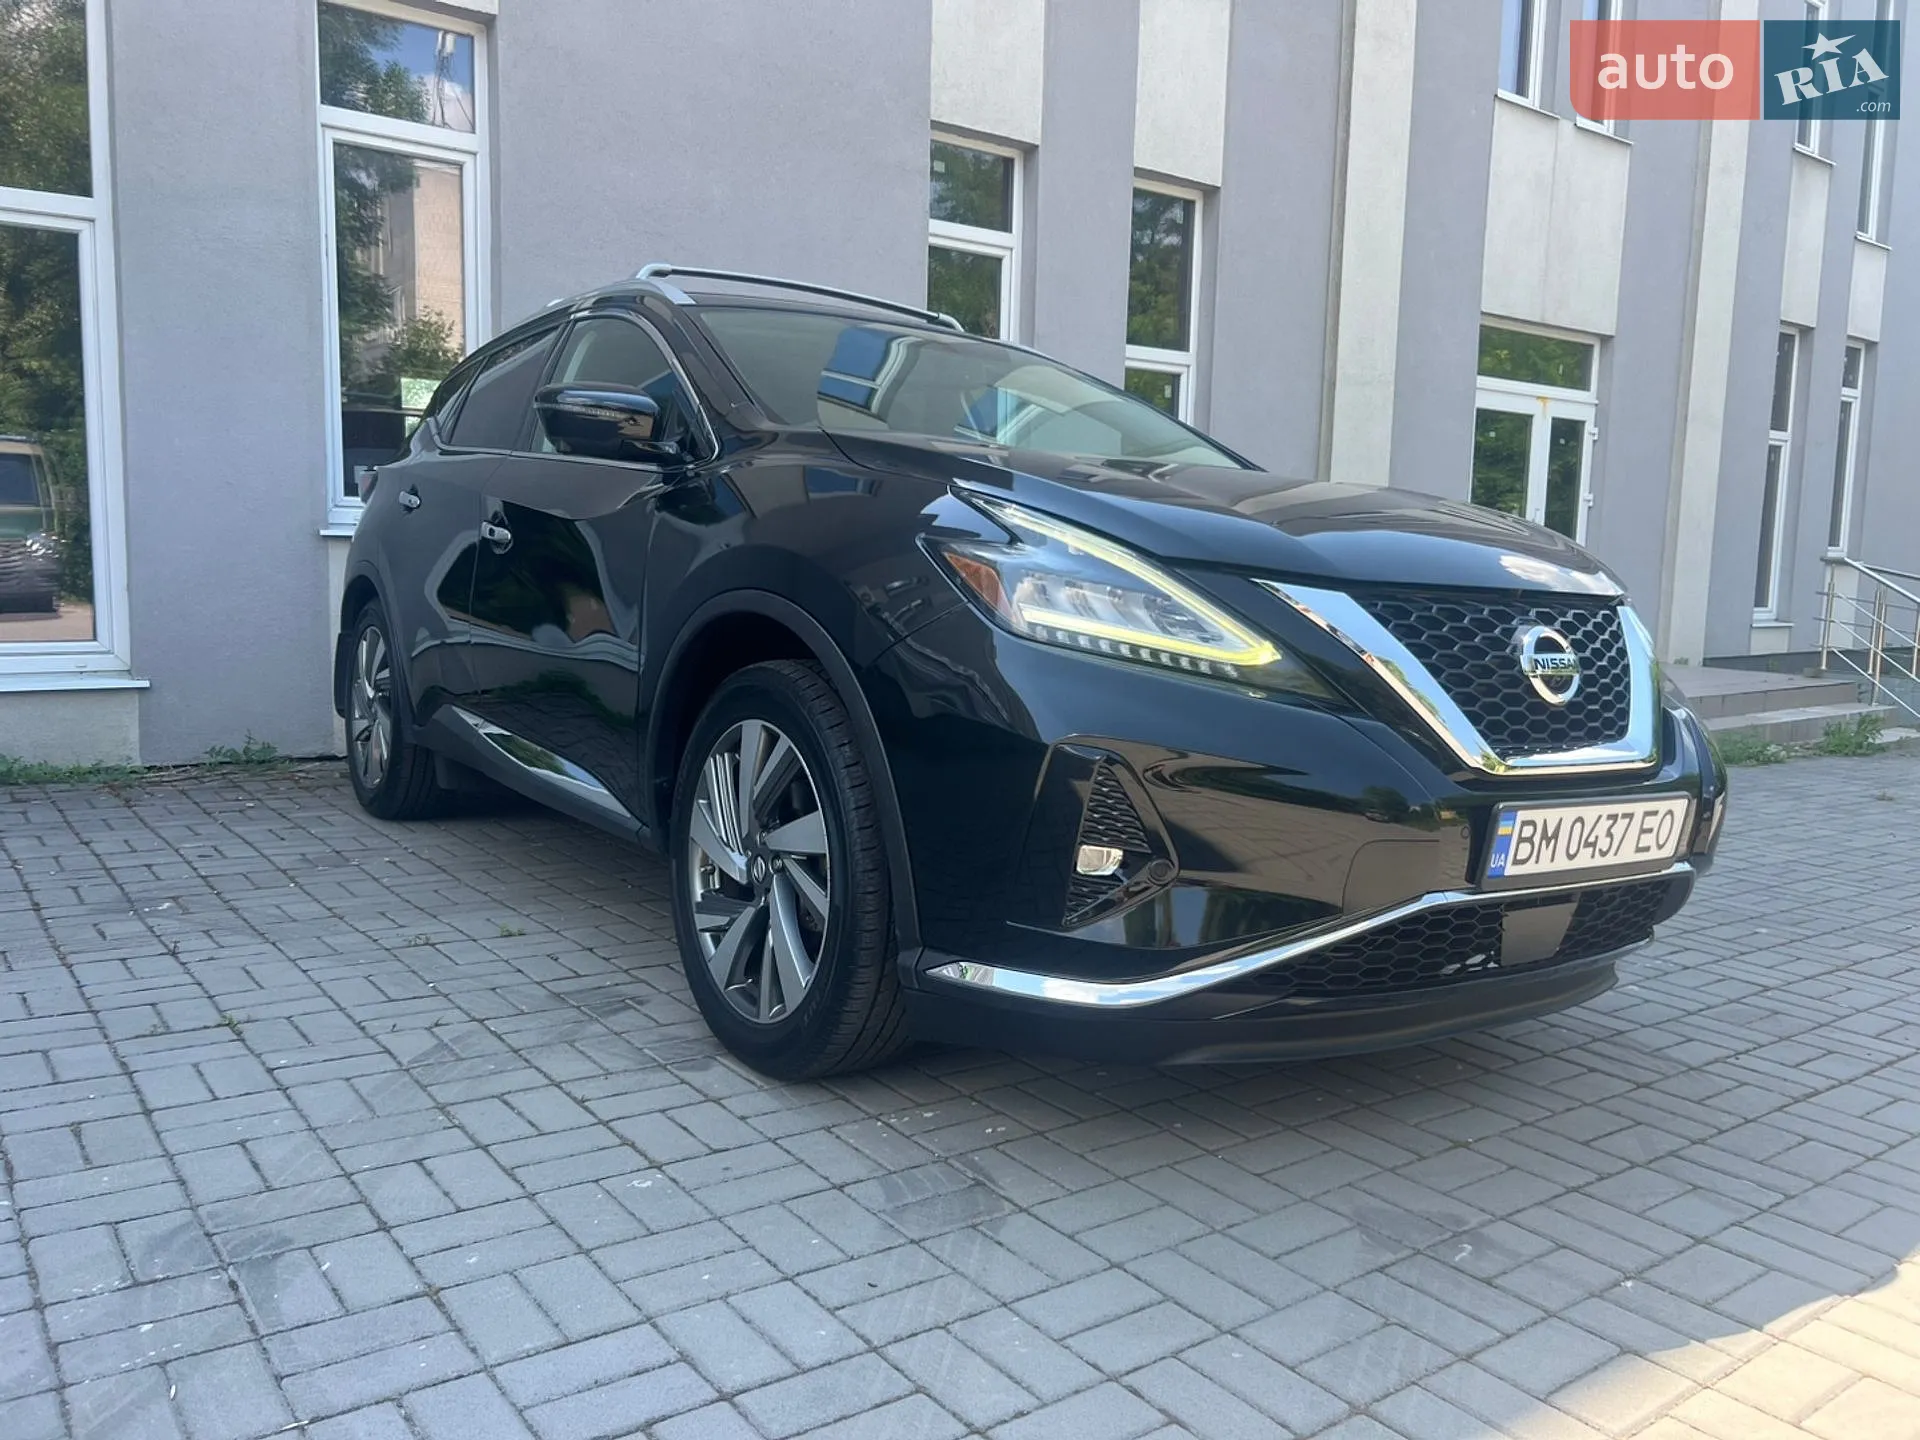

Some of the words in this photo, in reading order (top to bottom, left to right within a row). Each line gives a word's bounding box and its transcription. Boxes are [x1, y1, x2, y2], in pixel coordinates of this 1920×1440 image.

[1511, 816, 1563, 866] BM
[1566, 812, 1635, 861] 0437
[1634, 808, 1675, 854] EO
[1490, 853, 1505, 868] UA
